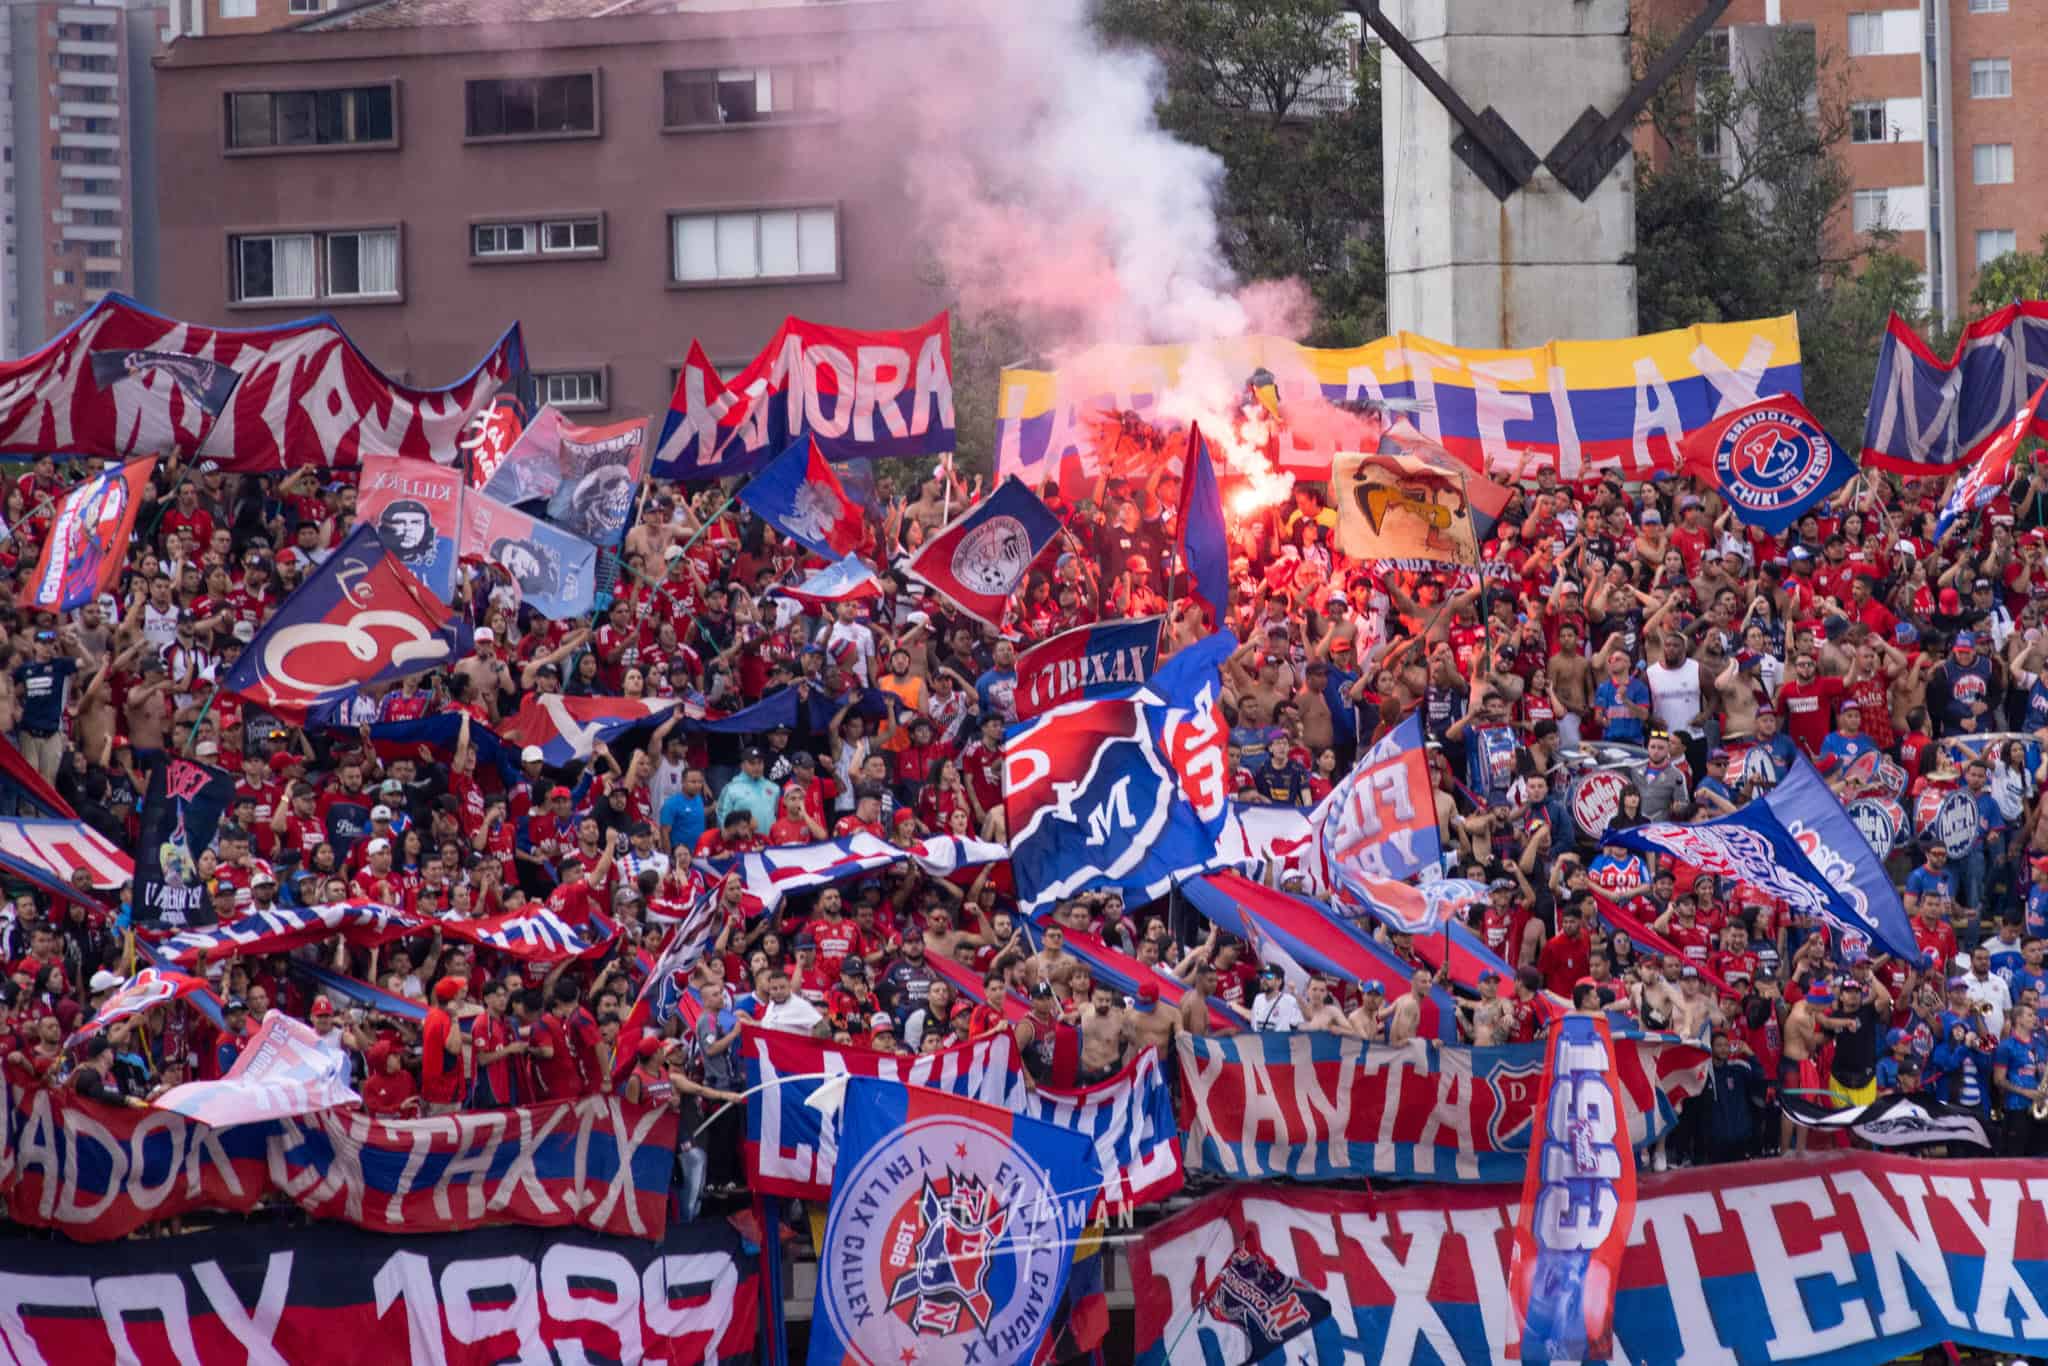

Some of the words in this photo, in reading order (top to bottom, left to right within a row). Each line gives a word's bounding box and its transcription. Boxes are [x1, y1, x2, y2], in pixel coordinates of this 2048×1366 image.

[1726, 410, 1803, 442] BANDOLA
[1729, 480, 1780, 506] CHIKI
[1792, 436, 1828, 496] ETERNO
[1175, 1032, 1481, 1180] XANTA
[885, 1156, 915, 1184] EN
[917, 1145, 932, 1167] Y
[849, 1178, 893, 1229] LAX
[841, 1233, 874, 1326] CALLEX
[962, 1270, 1050, 1366] CANCHAX
